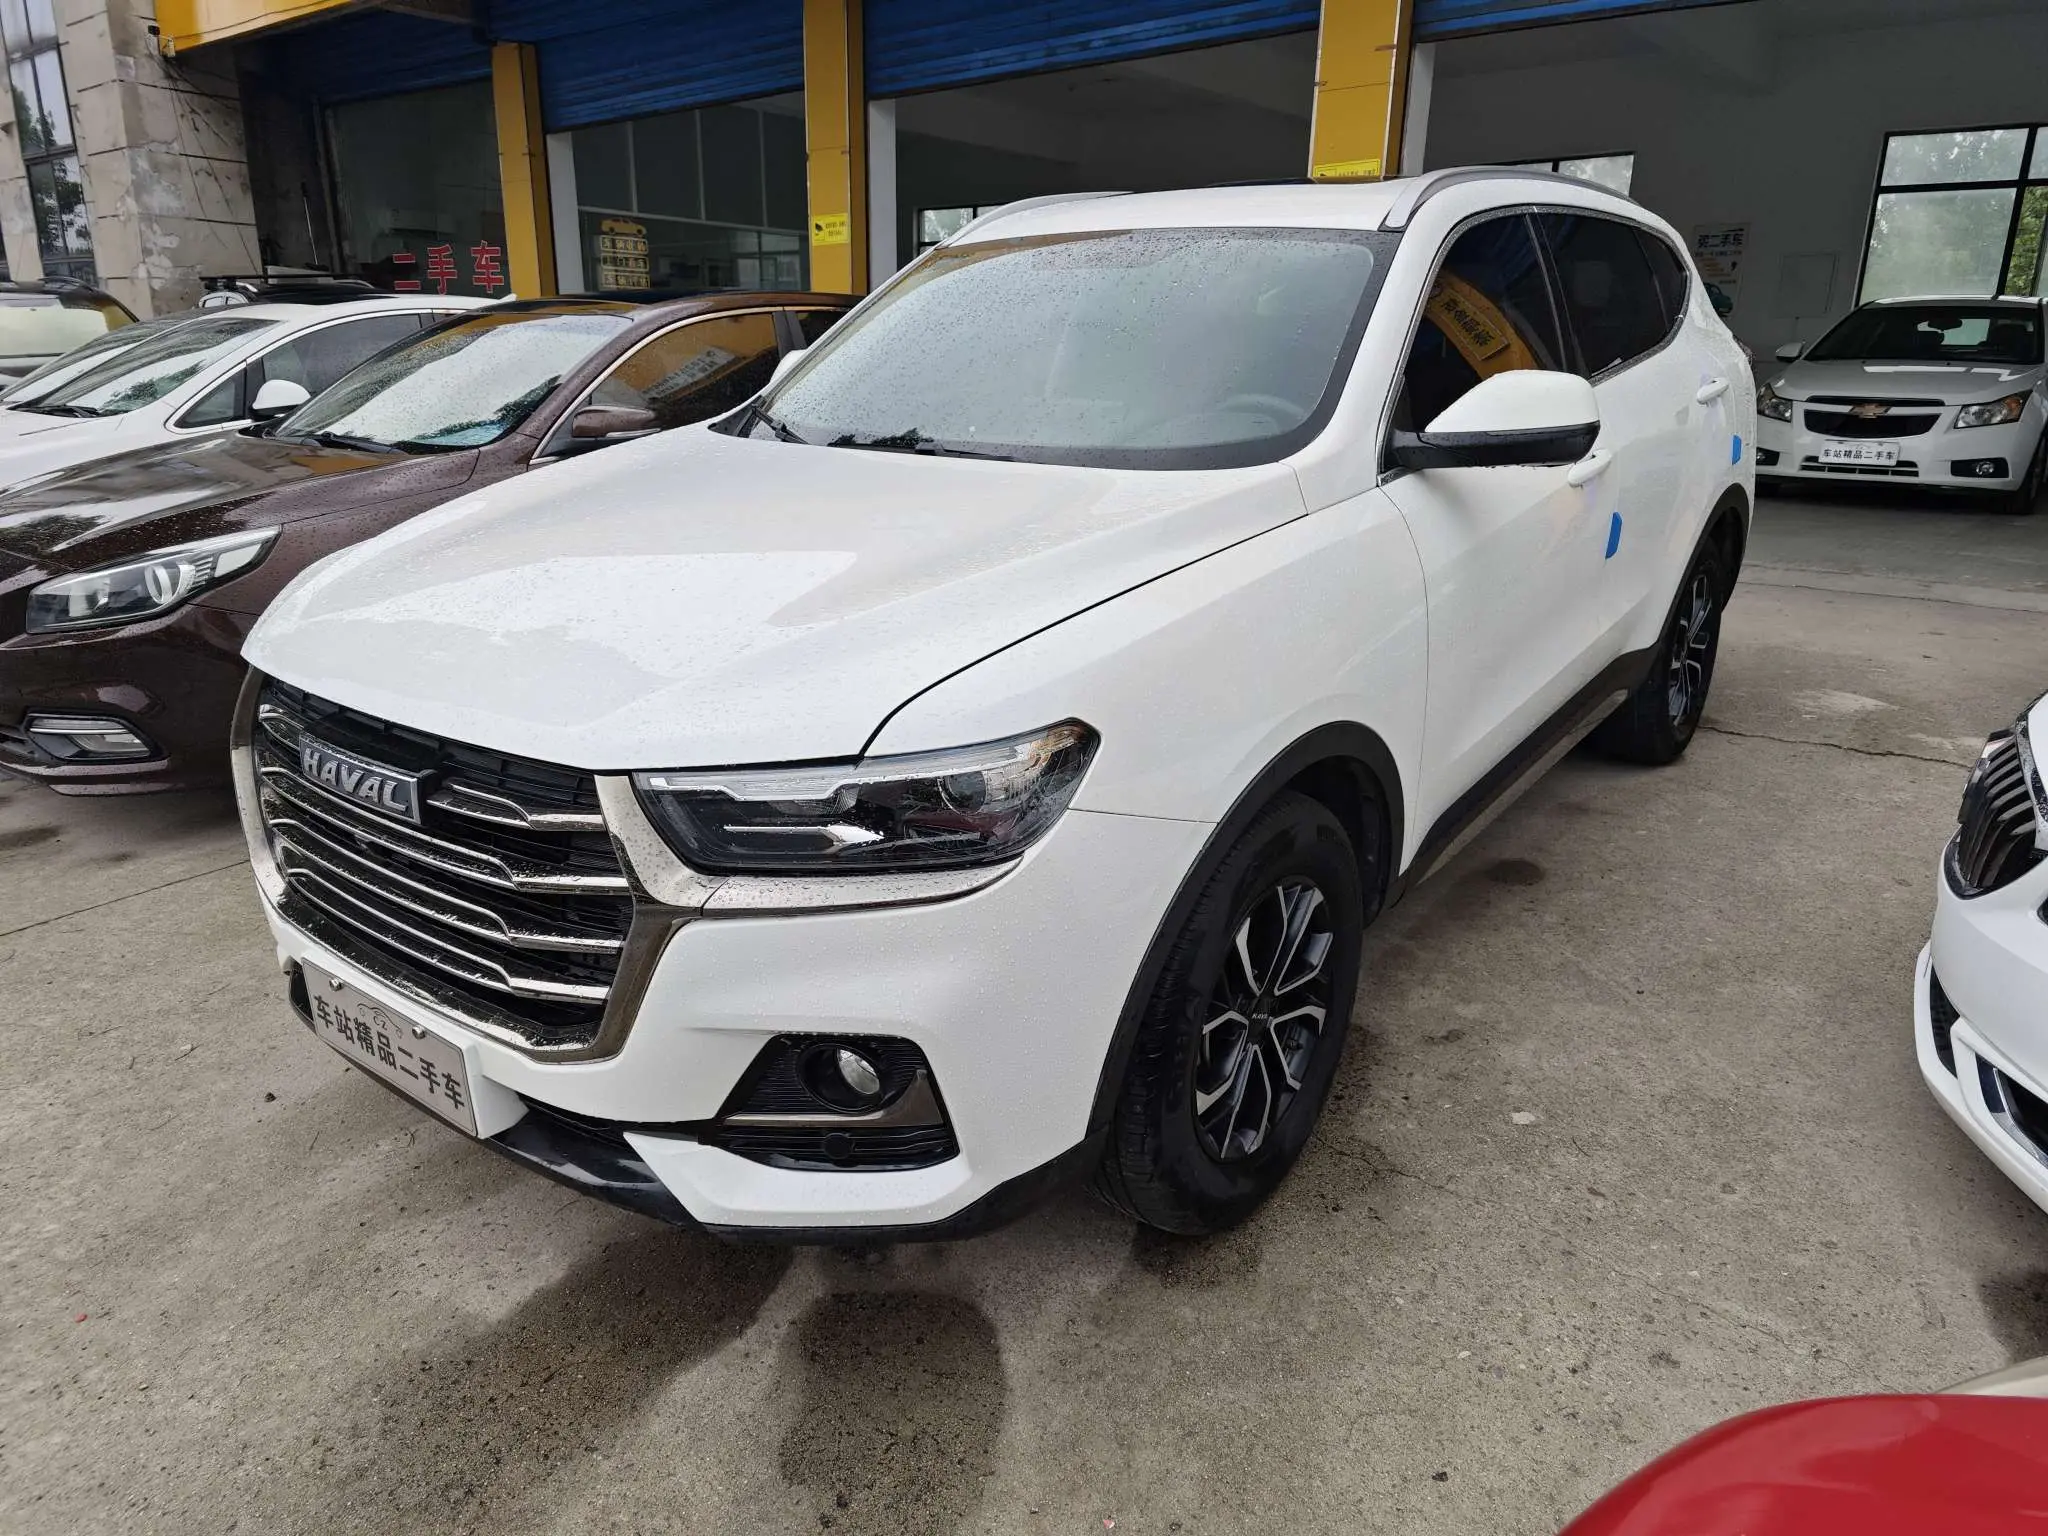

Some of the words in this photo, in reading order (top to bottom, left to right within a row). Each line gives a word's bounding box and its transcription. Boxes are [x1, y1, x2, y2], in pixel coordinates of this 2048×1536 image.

[393, 240, 504, 295] 二手车
[1823, 448, 1895, 460] 车站精品二手车
[302, 747, 408, 812] HAVAL
[314, 994, 465, 1110] 车站精品二手车
